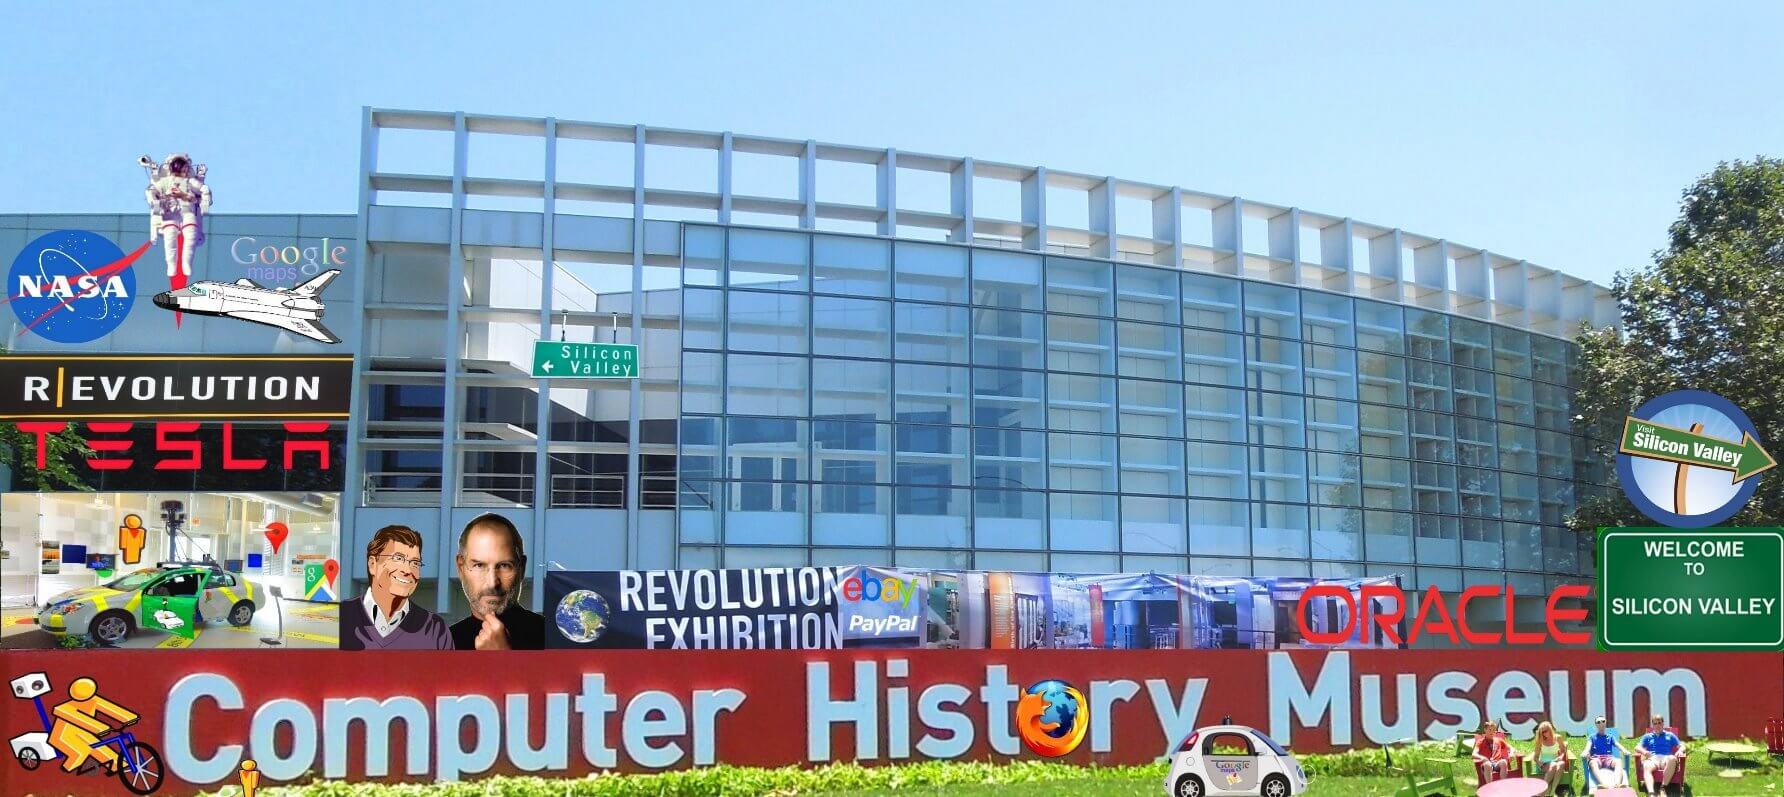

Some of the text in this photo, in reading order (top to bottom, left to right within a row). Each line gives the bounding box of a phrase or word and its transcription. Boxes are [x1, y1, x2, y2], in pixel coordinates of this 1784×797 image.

[561, 345, 631, 359] Silicon
[570, 360, 631, 377] Valley
[1637, 424, 1655, 435] Visit
[1633, 432, 1743, 467] Silicon Valley
[1644, 541, 1744, 557] WELCOME
[1684, 563, 1705, 575] TO
[619, 567, 843, 612] REVOLUTION
[1612, 598, 1776, 615] SILICON VALLEY
[646, 612, 843, 649] EXHIBITION
[163, 651, 1707, 784] Computer Histry Museum
